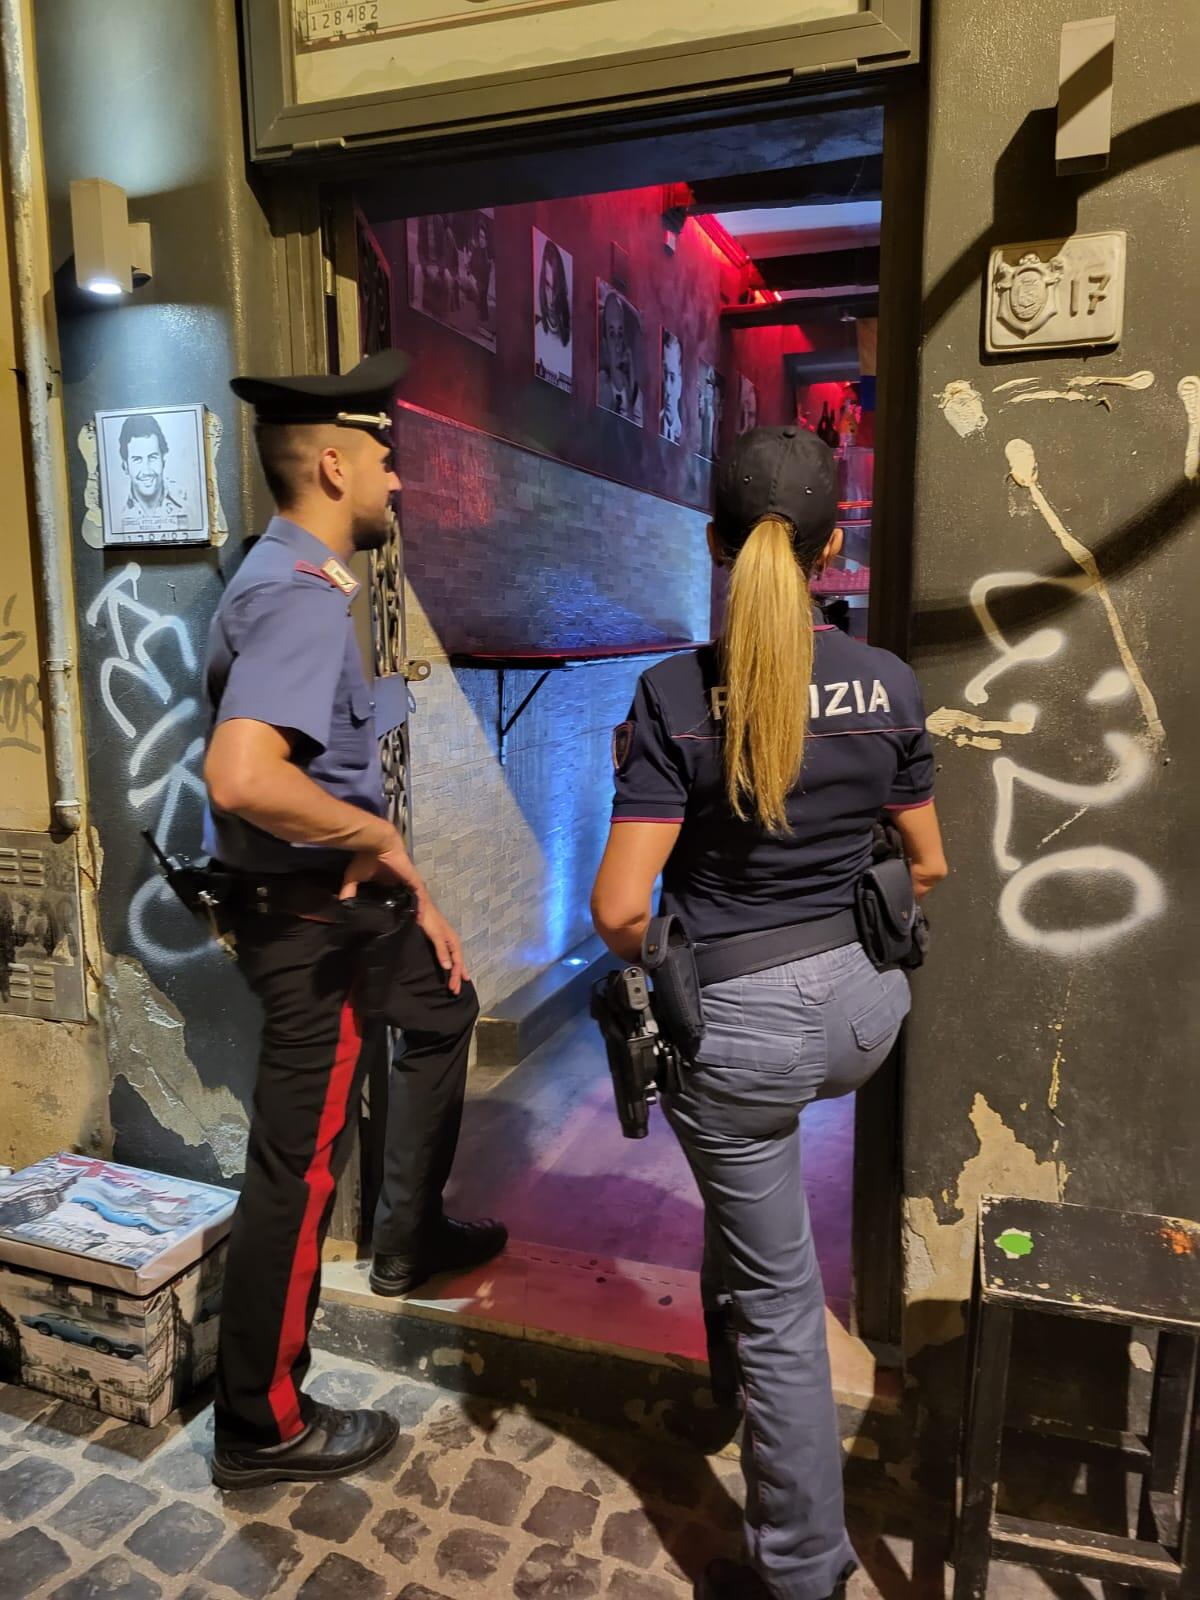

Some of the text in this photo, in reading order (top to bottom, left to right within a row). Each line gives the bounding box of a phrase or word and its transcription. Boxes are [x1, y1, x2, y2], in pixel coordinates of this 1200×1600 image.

[311, 4, 378, 31] 128482
[1069, 274, 1111, 317] 17
[711, 679, 891, 720] PIZIA
